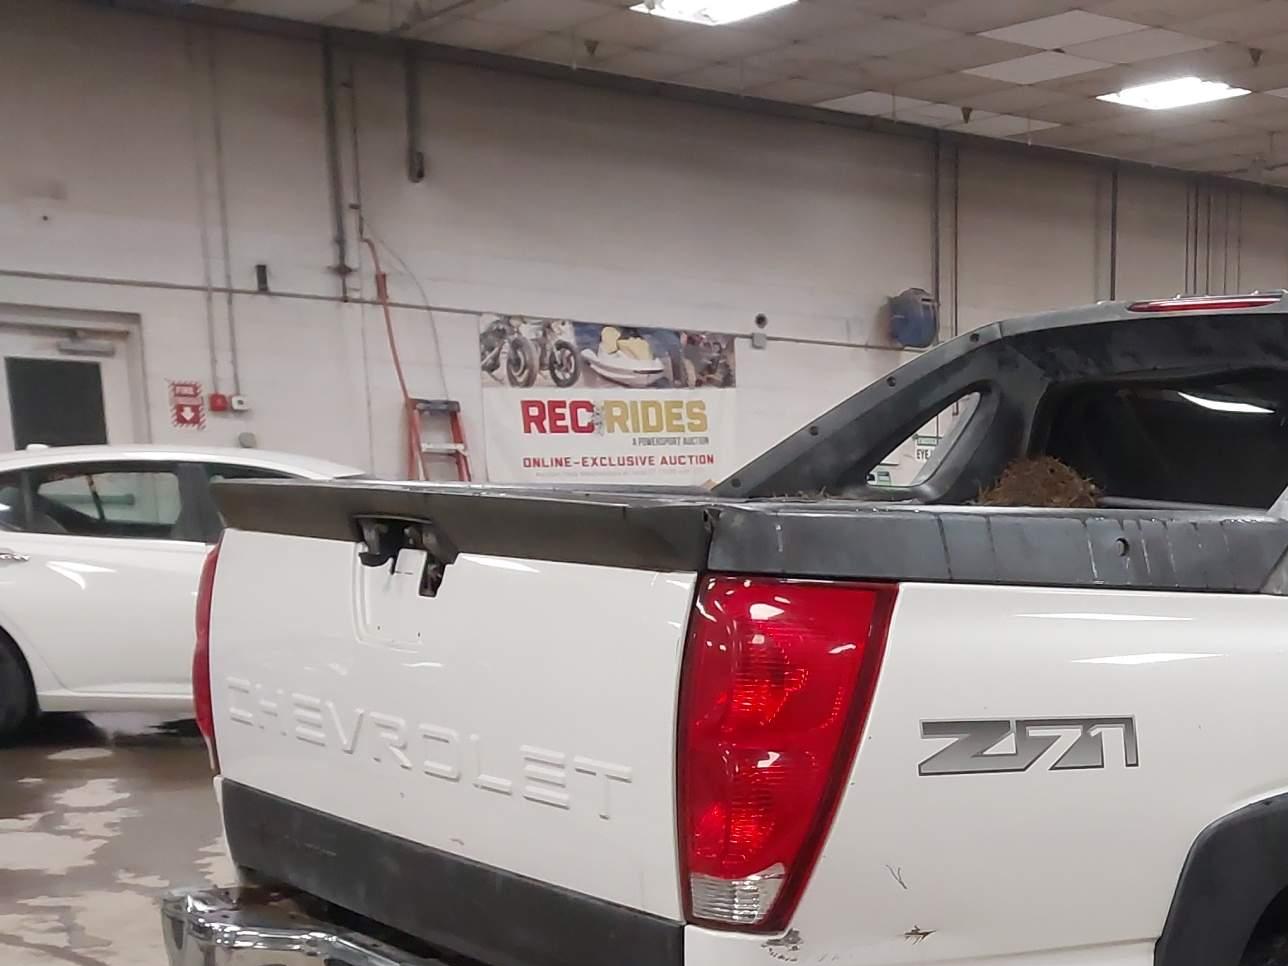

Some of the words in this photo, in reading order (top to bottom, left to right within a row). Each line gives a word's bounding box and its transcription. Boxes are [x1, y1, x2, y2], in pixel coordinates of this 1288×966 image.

[520, 399, 595, 434] REC
[603, 399, 708, 433] RIDES
[683, 436, 709, 445] AUCTION
[523, 456, 655, 468] ONLINE-EXCLUSIVE
[660, 453, 715, 466] AUCTION
[916, 448, 929, 460] EYE
[226, 675, 633, 820] CHEVROLET
[917, 714, 1139, 777] Z71
